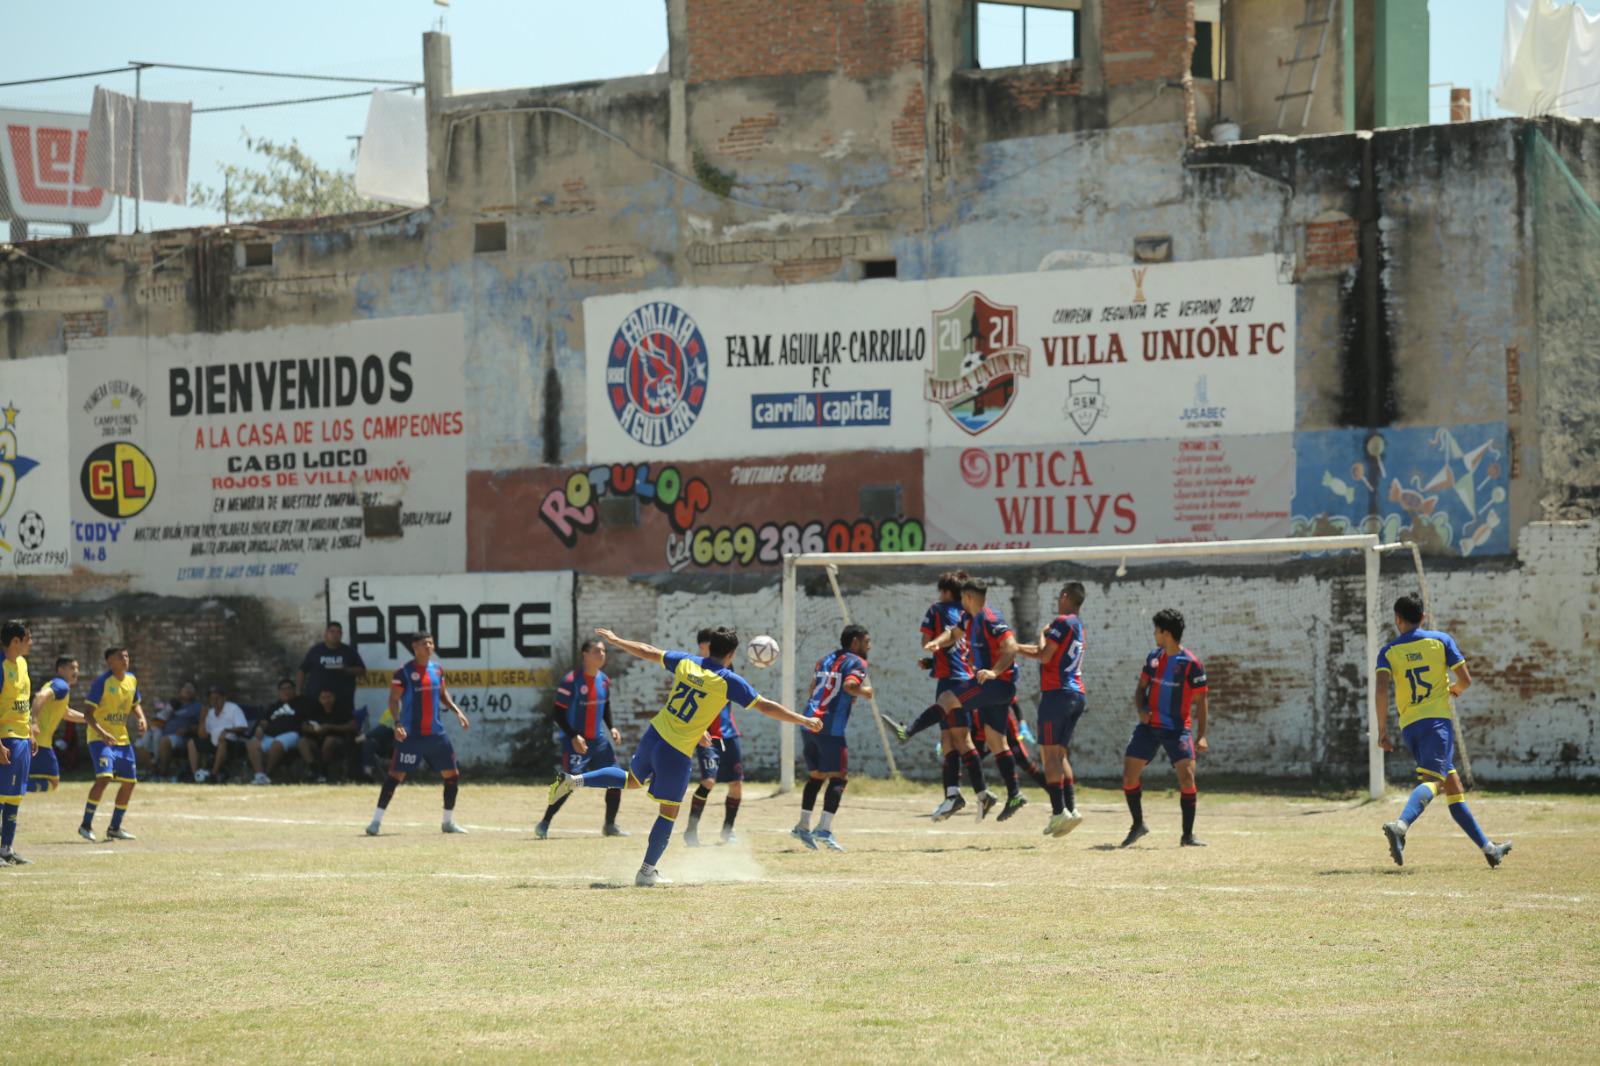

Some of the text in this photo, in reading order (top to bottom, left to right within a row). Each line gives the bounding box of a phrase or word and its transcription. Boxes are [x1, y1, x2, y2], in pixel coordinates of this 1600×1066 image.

[1154, 302, 1170, 318] DE
[1229, 296, 1255, 313] 2021
[725, 335, 774, 367] FAM.
[938, 318, 962, 350] 20
[1041, 317, 1286, 367] VILLA UNIÓN FC
[169, 350, 414, 417] BIENVENIDOS
[812, 367, 831, 388] FC
[620, 400, 697, 446] AGUILAR
[754, 394, 815, 423] carrillo
[194, 411, 463, 450] A LA CASA DE LOS CAMPEONES
[212, 459, 411, 490] ROJOS DE VILLA UNIÓN
[228, 448, 368, 473] CABO LOCO
[995, 492, 1137, 535] WILLYS
[348, 580, 375, 601] EL
[348, 602, 552, 659] PROFE
[665, 681, 708, 724] 26
[1404, 665, 1433, 705] 15
